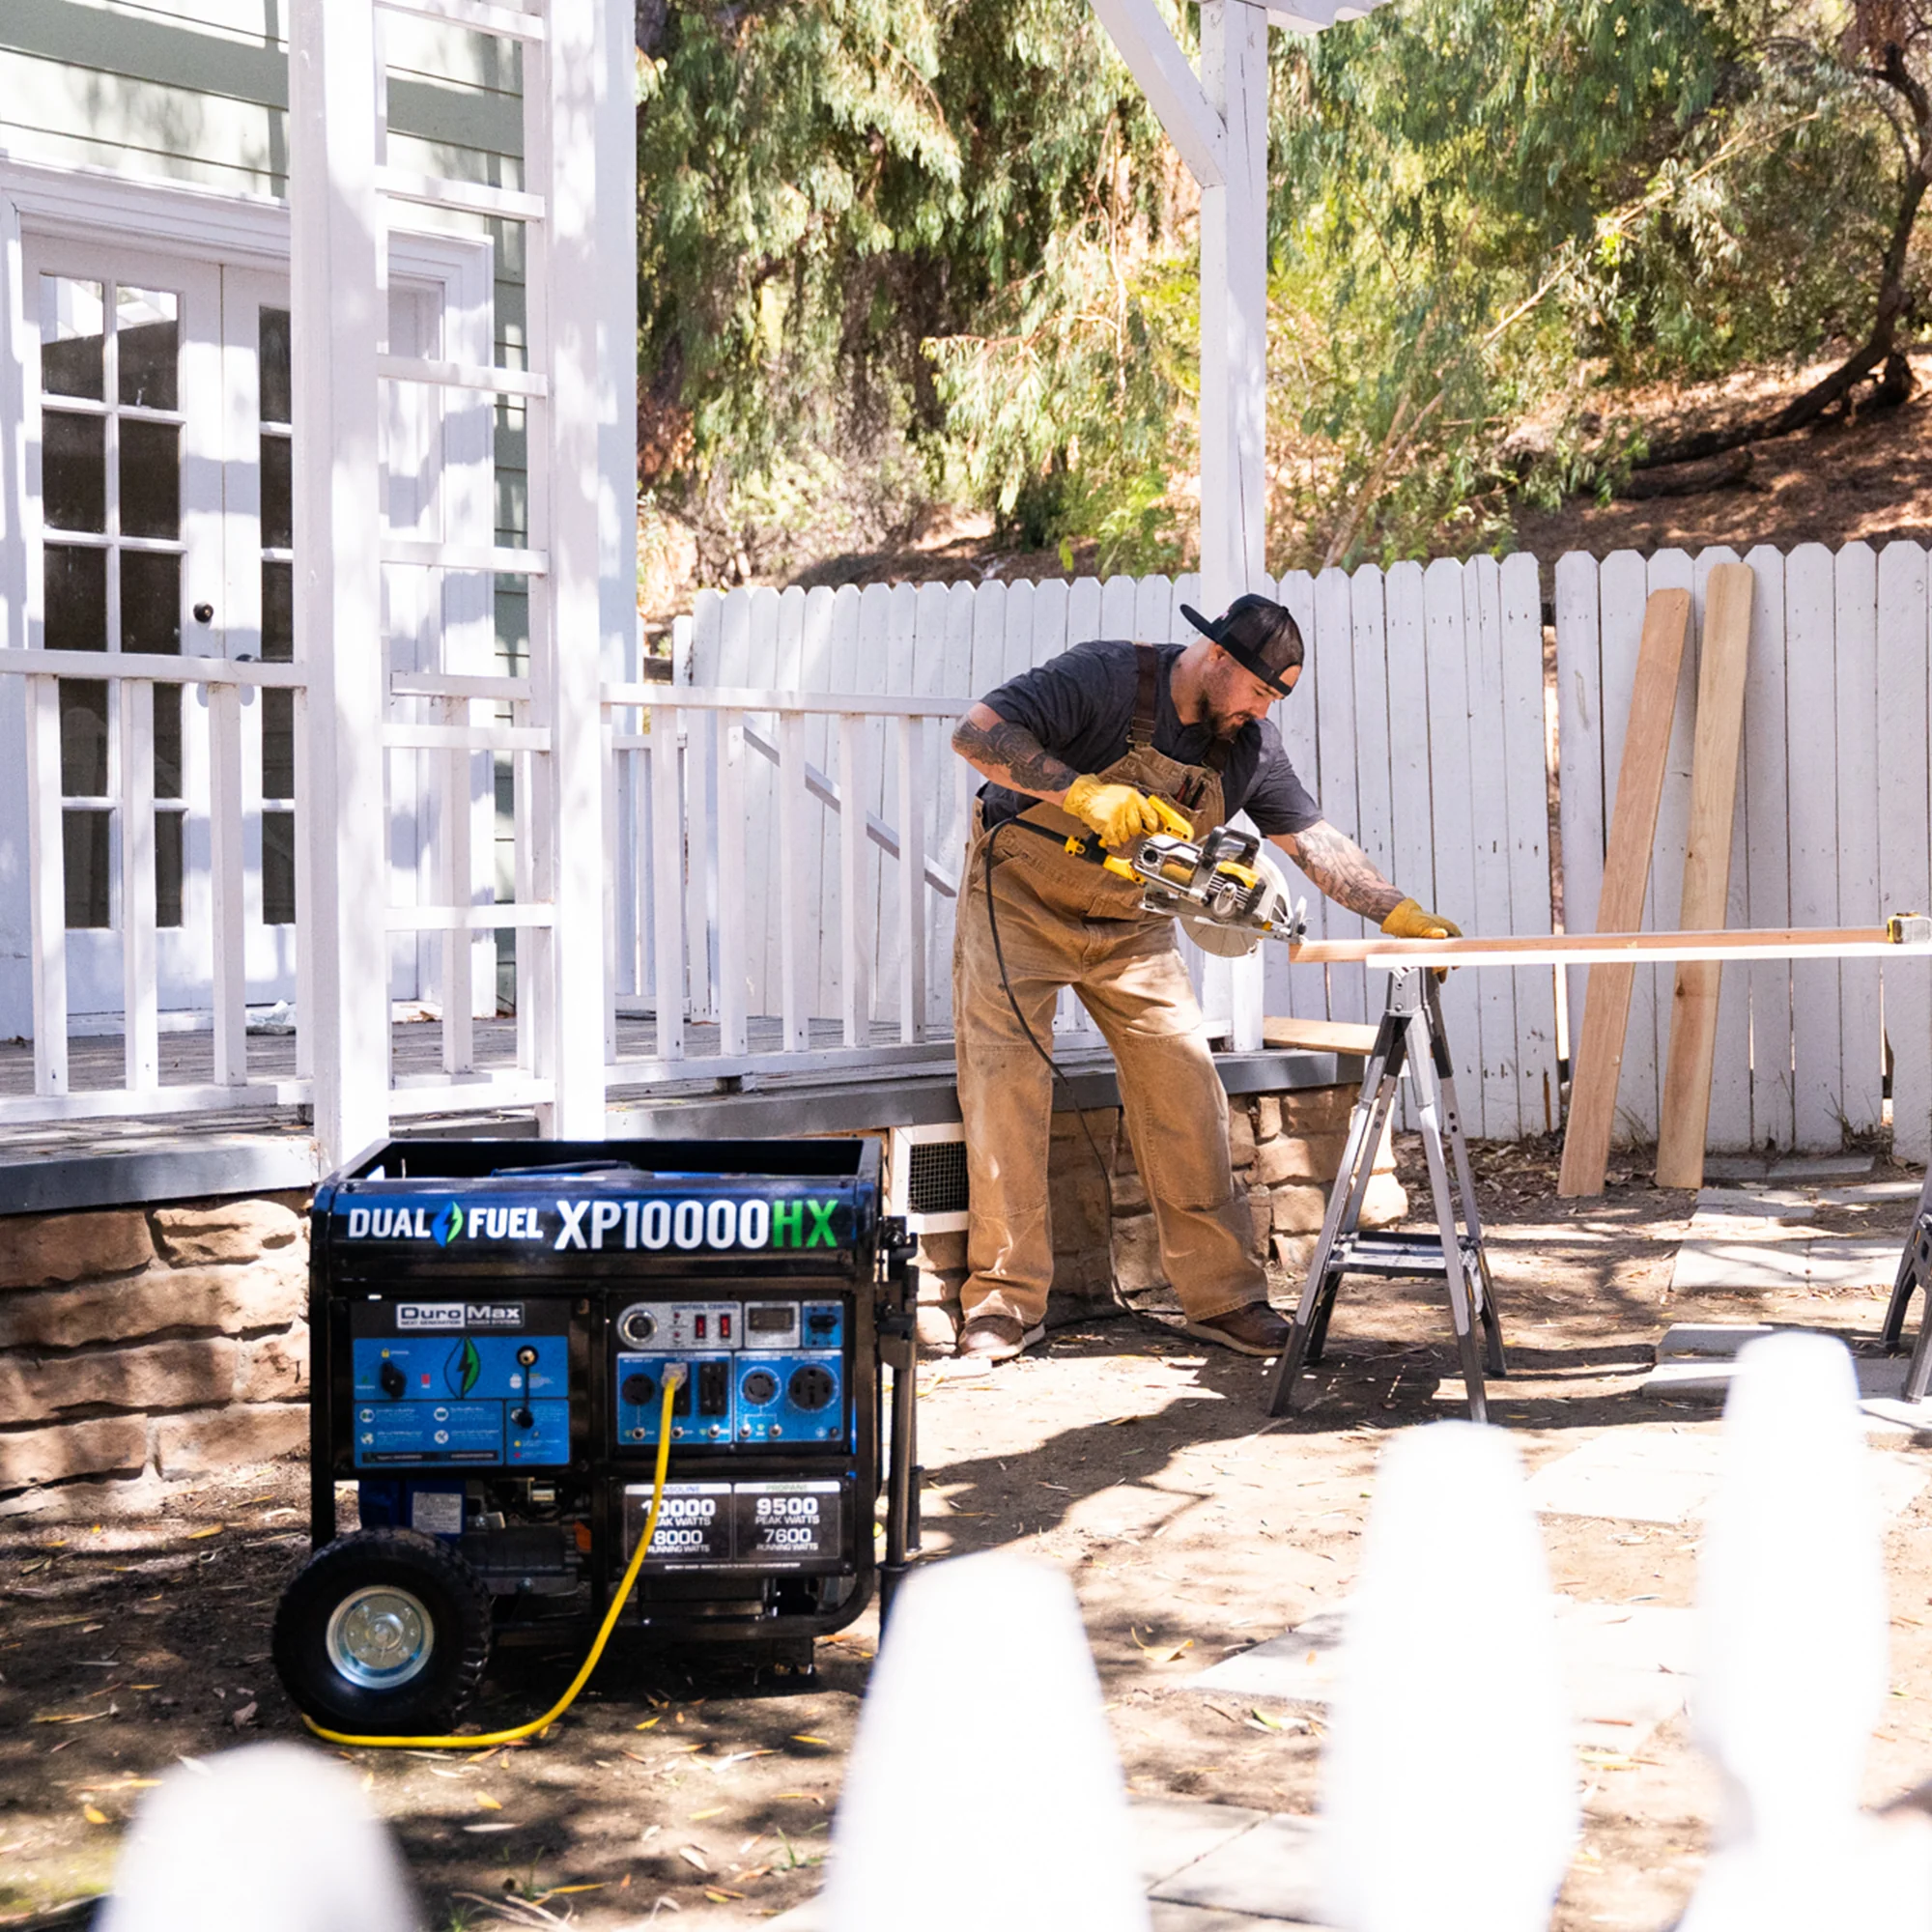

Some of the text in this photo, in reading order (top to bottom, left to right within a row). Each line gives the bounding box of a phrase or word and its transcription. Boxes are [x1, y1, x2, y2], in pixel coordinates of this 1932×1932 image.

[349, 1200, 838, 1250] DUAL FUEL XP10000HX
[756, 1497, 818, 1516] 9500
[675, 1517, 711, 1525] WATTS
[755, 1515, 820, 1524] PEAK WATTS
[654, 1530, 702, 1546] 8000
[763, 1528, 811, 1543] 7600
[756, 1542, 818, 1551] RUNNING WATTS
